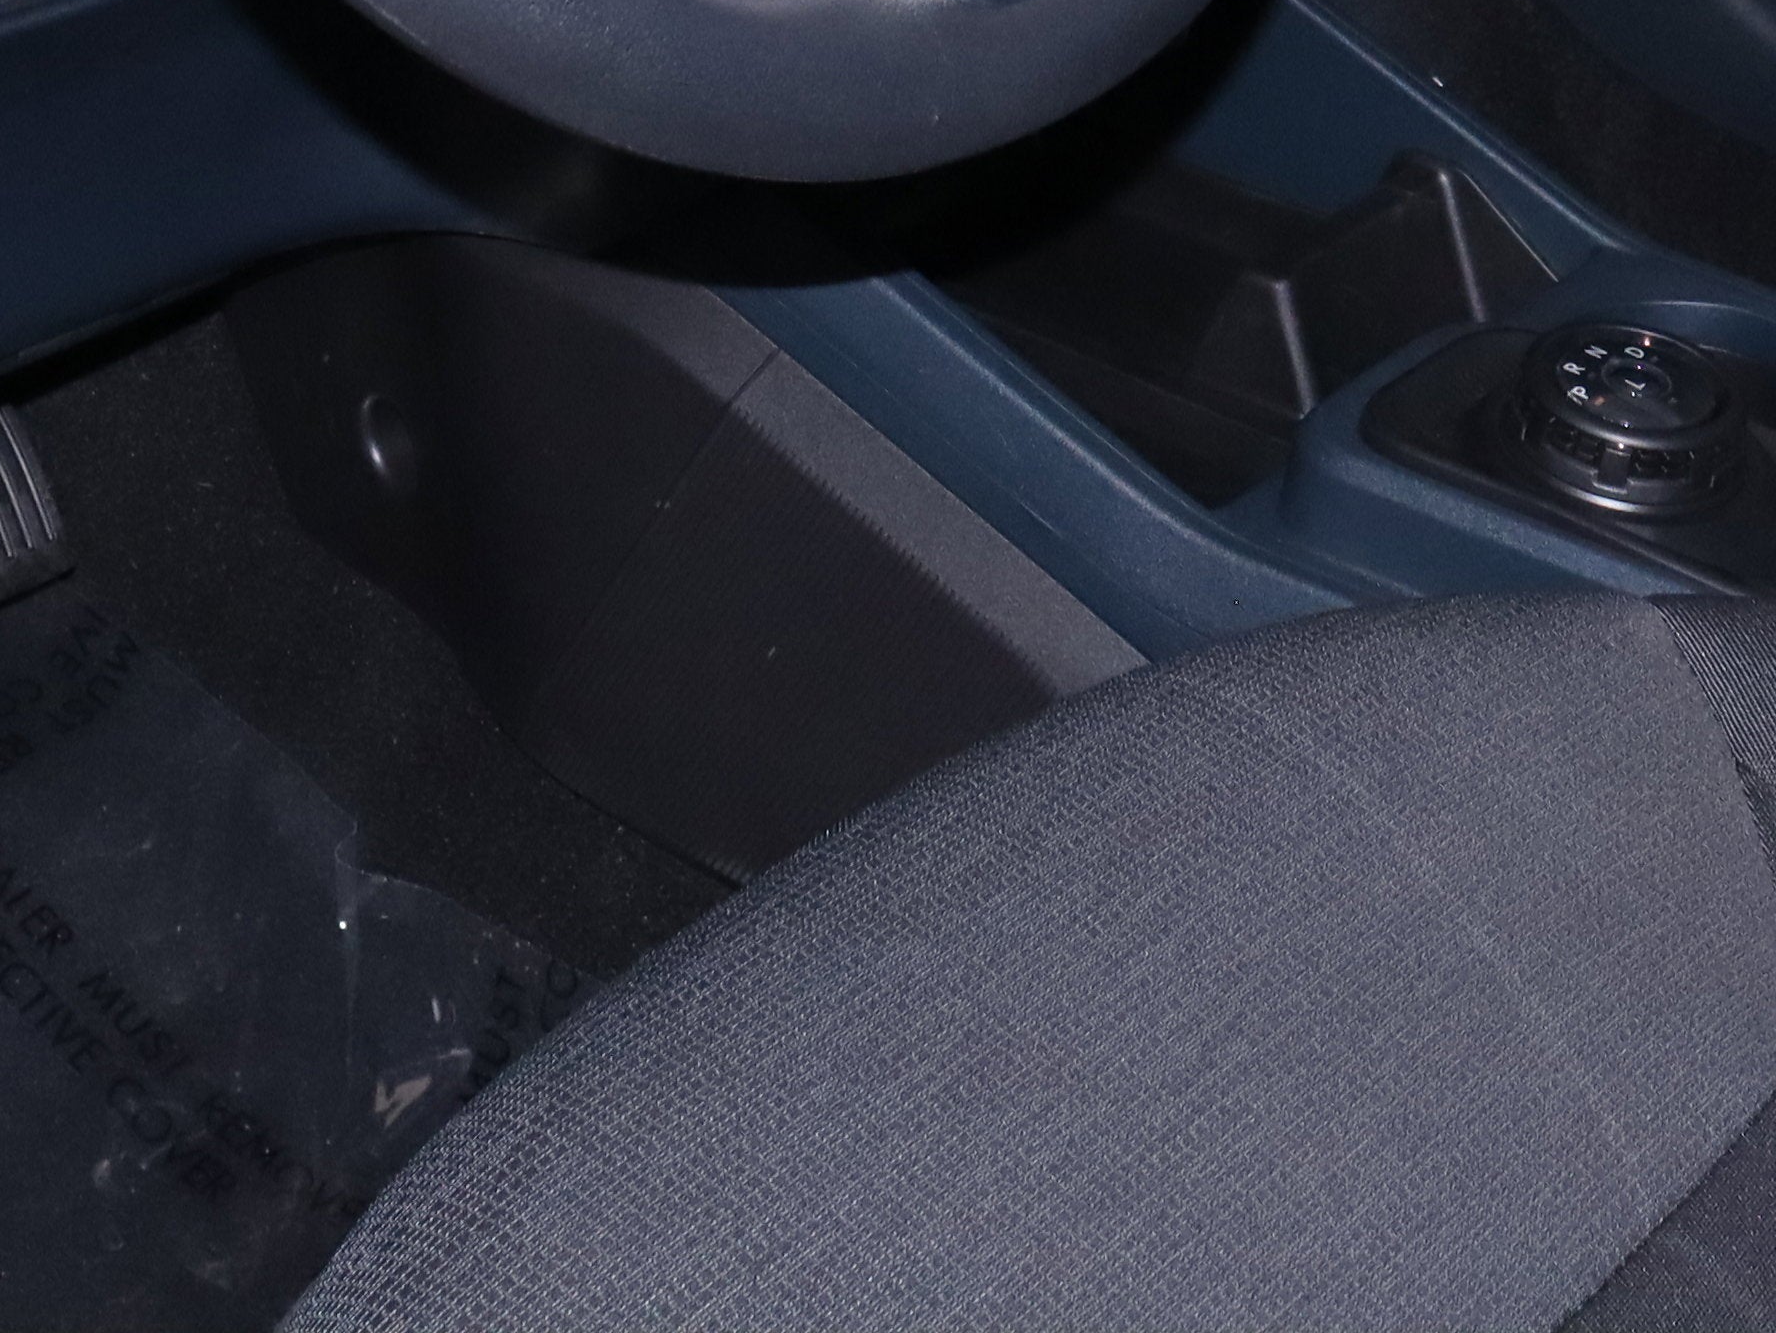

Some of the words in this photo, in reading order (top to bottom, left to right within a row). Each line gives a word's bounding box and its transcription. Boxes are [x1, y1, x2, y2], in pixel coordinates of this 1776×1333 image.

[1584, 344, 1608, 359] N
[1624, 346, 1645, 359] D
[1562, 362, 1586, 375] R
[1569, 385, 1590, 402] P
[77, 968, 196, 1076] MUST
[104, 1073, 242, 1206] COVER
